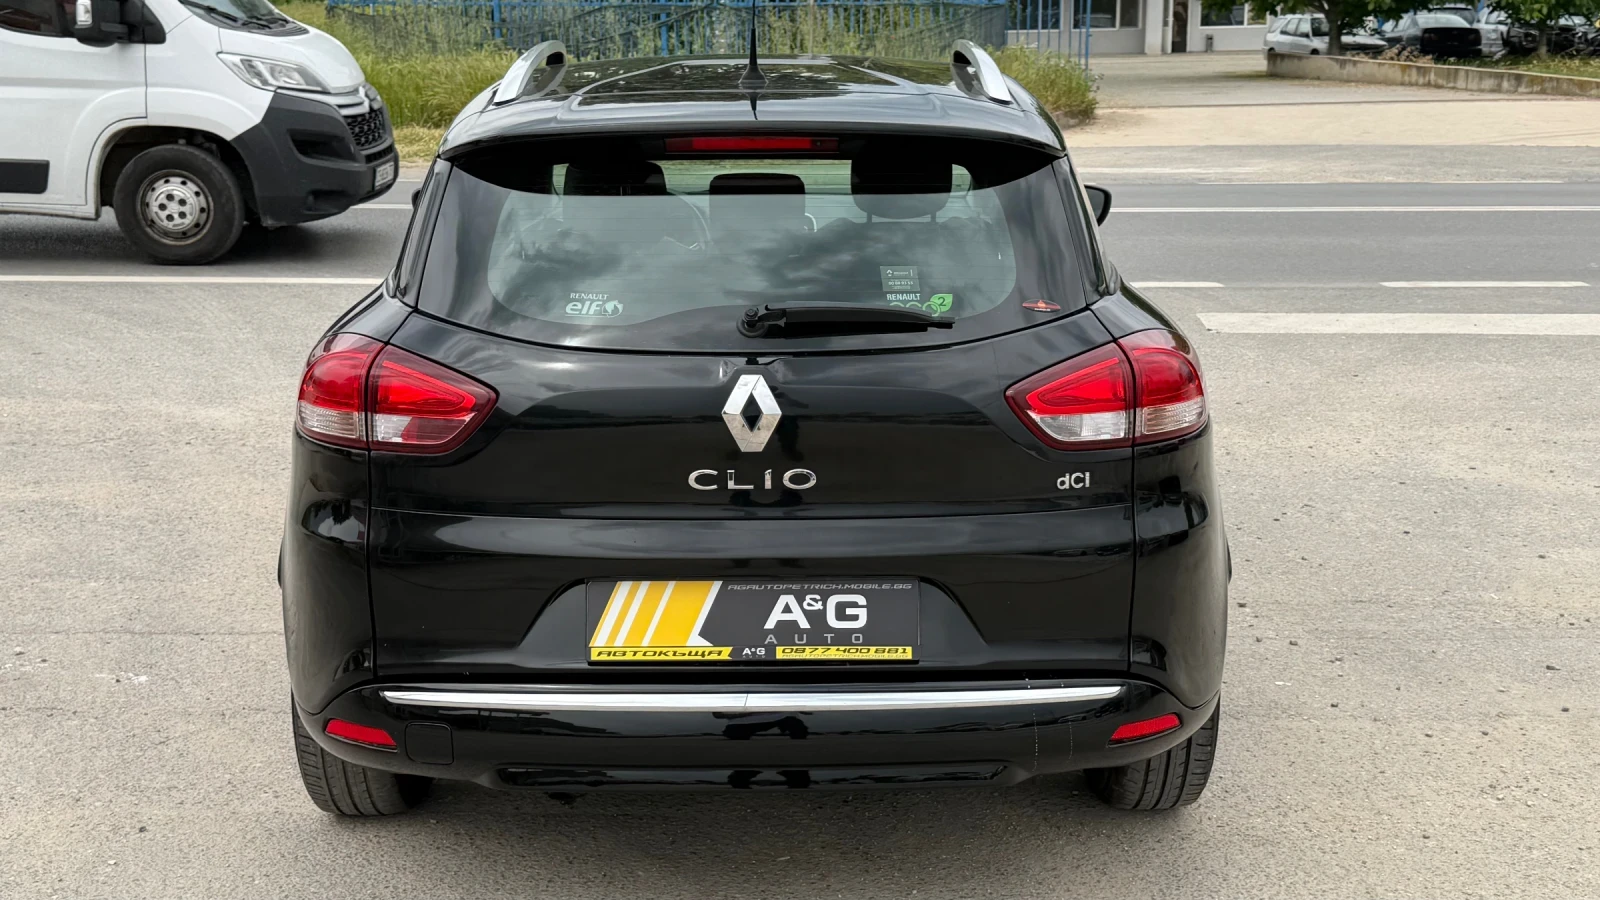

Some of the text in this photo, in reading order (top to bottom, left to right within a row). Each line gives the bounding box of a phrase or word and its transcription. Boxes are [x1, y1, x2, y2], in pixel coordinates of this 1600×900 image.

[886, 293, 921, 301] RENAULT
[565, 301, 603, 314] elf
[688, 468, 817, 491] CLIO
[727, 583, 913, 591] AGAUTOPETRICH.MOBILE.BG
[763, 594, 868, 630] A&G
[764, 633, 864, 645] AUTO
[596, 650, 722, 658] АВТОКЪЩА
